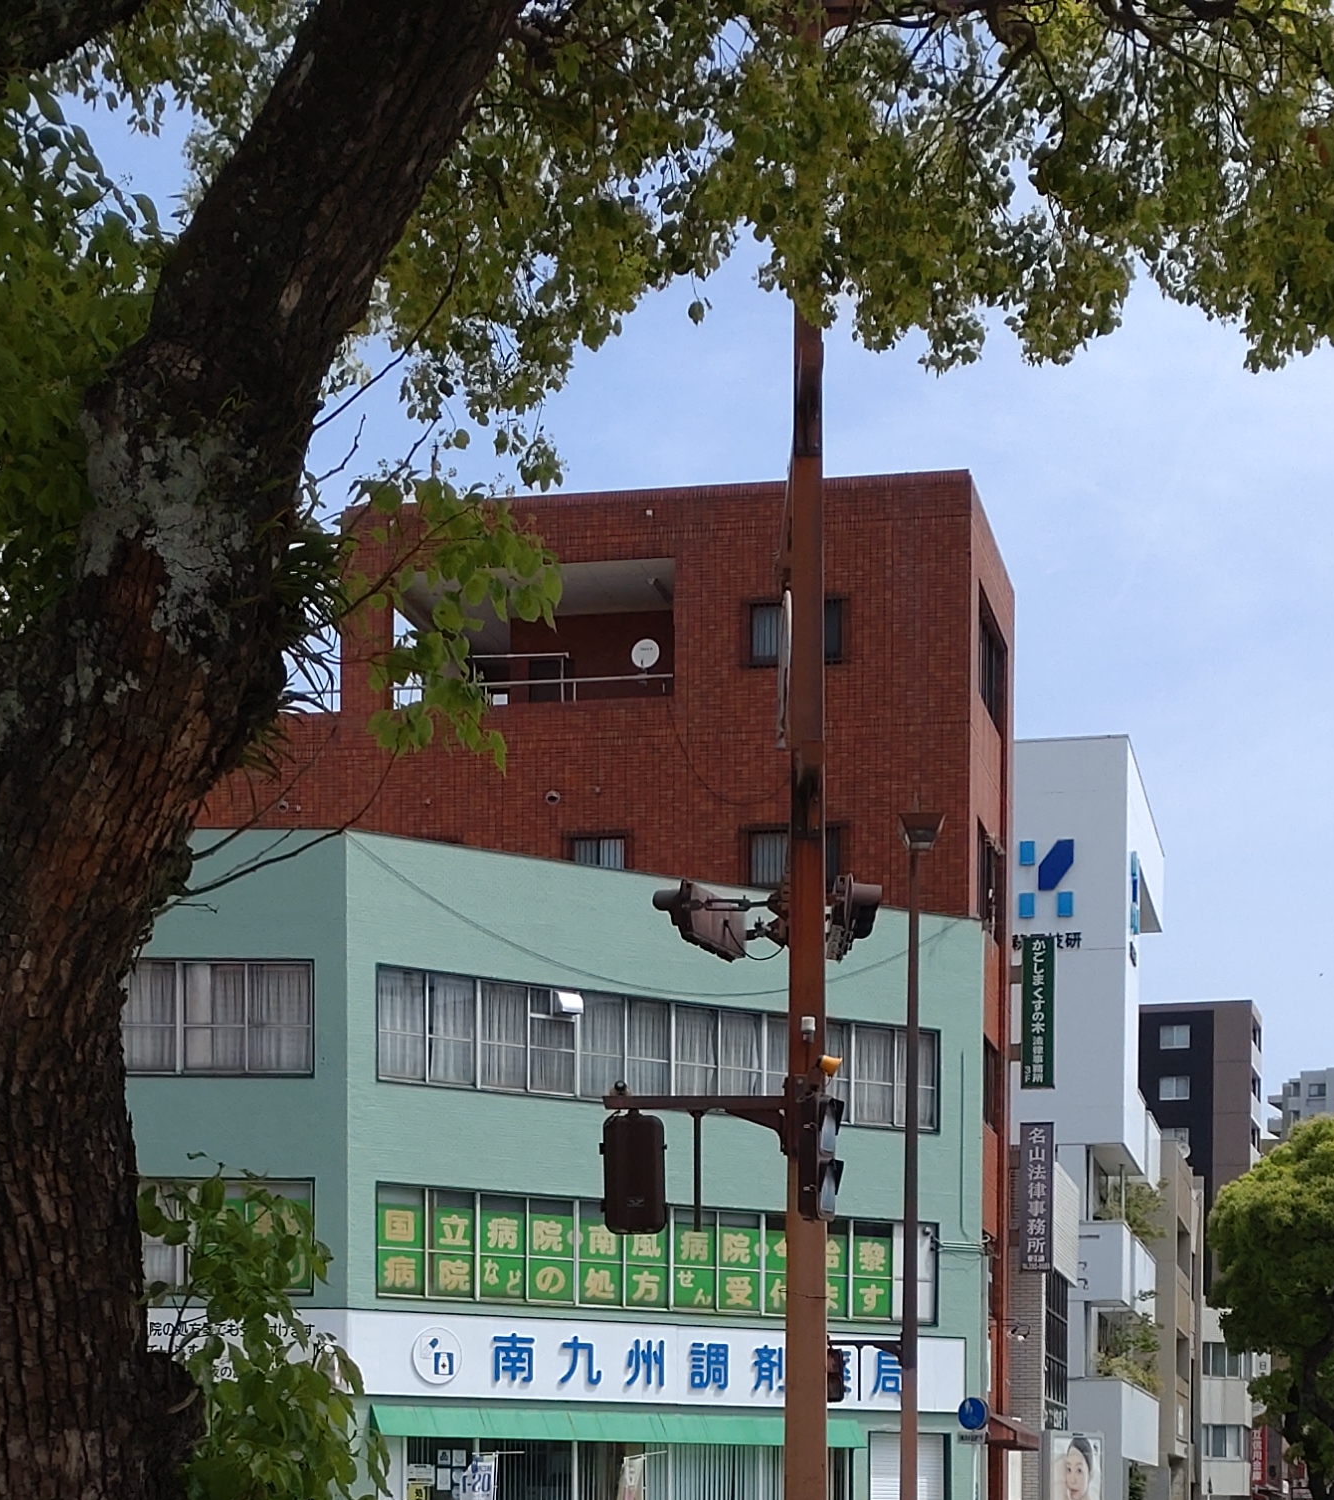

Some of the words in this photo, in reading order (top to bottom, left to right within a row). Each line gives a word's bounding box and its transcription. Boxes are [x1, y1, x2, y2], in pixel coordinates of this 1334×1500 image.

[1031, 939, 1046, 1034] かごしまくすの木
[1027, 1127, 1047, 1254] 名山法律事務所
[492, 1332, 903, 1396] 南九州調剤局
